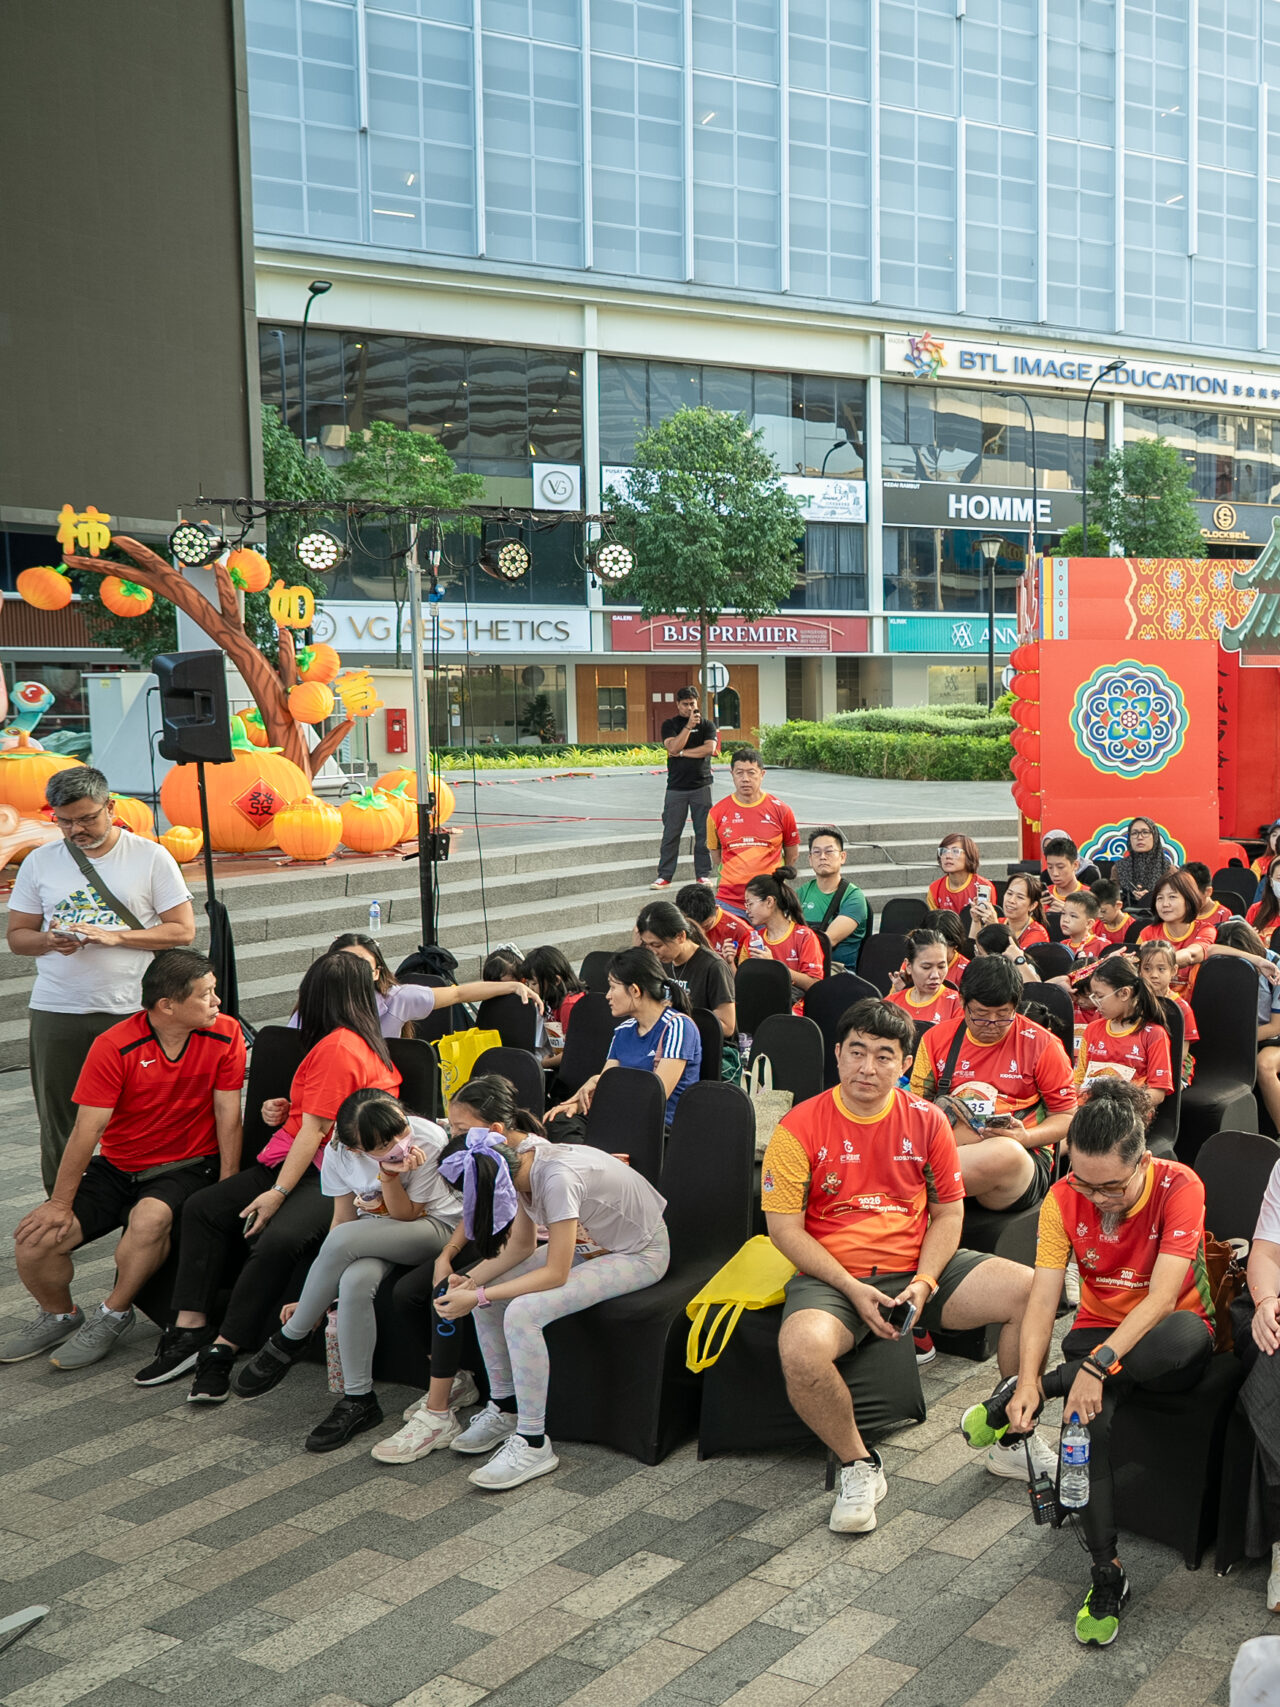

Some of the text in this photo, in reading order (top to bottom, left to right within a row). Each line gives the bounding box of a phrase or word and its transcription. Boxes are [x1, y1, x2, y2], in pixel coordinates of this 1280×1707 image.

[959, 350, 1007, 373] BTL
[1013, 356, 1093, 381] IMAGE
[1099, 363, 1229, 395] EDUCATION
[548, 479, 567, 496] VG
[948, 494, 1051, 523] HOMME
[56, 503, 111, 557] 柿
[348, 615, 391, 640] VG
[663, 625, 701, 643] BJS
[709, 625, 799, 643] PREMIER
[248, 791, 273, 816] 發
